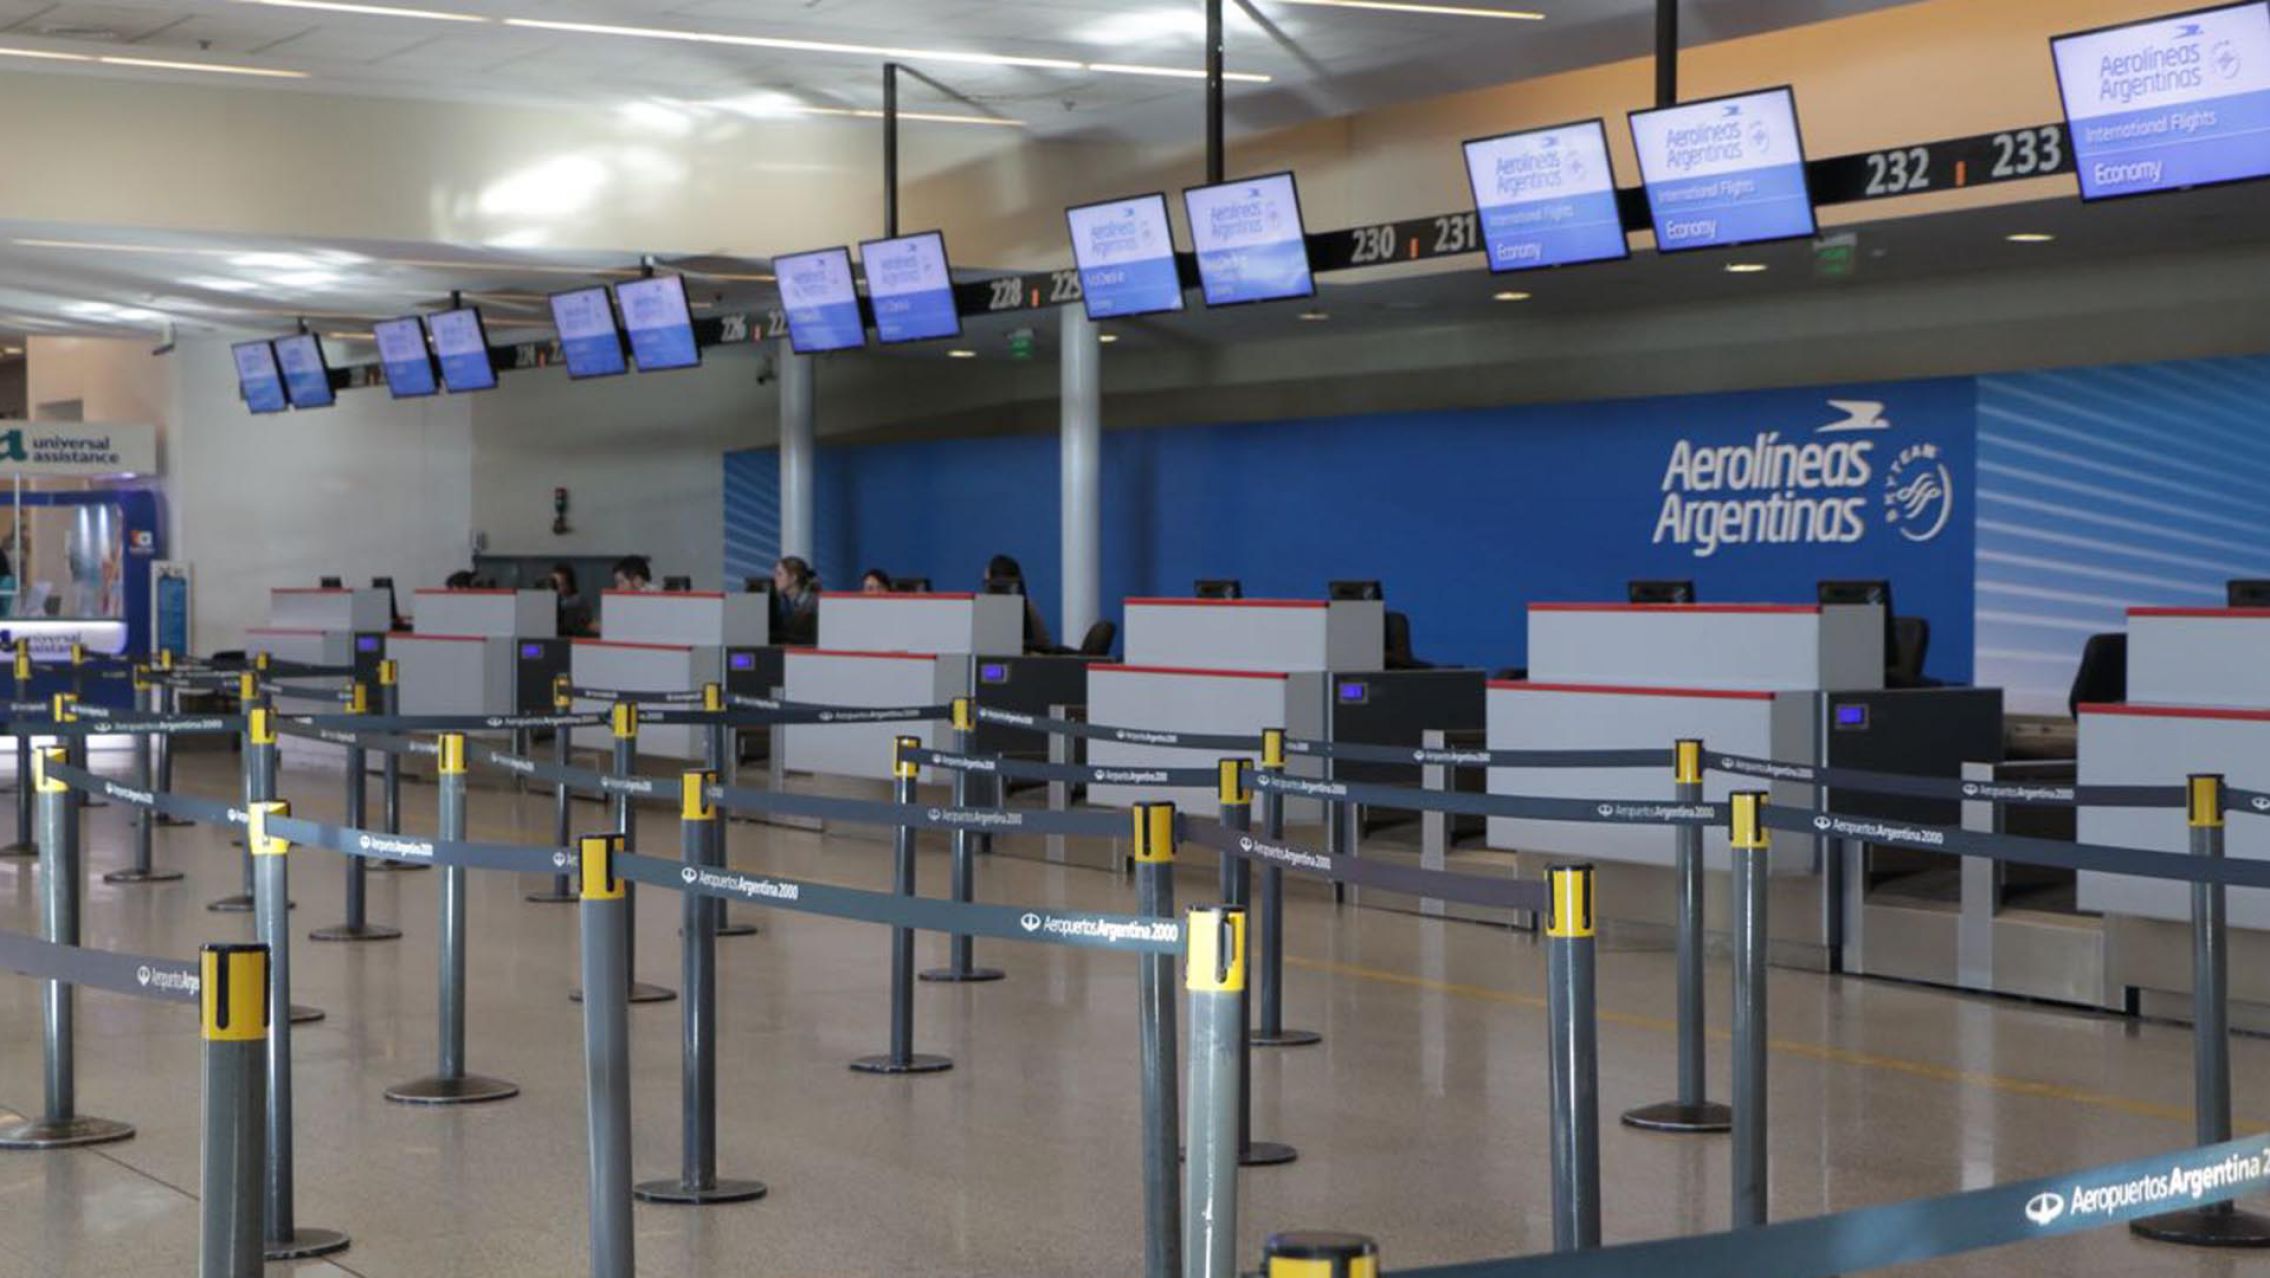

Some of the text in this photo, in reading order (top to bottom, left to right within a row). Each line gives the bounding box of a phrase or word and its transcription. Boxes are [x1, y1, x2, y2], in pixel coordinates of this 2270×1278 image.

[2100, 67, 2202, 103] Argentinas
[2086, 111, 2217, 143] International Flights
[1666, 142, 1743, 171] Argentinas
[1991, 126, 2063, 179] 233
[1865, 147, 1930, 196] 232
[2094, 160, 2162, 185] Economy
[1350, 225, 1396, 264] 230
[1434, 214, 1477, 251] 231
[1665, 219, 1717, 240] Economy
[989, 276, 1022, 311] 228
[32, 436, 110, 450] universal
[33, 451, 120, 464] assistance
[1661, 431, 1874, 491] Aerolíneas
[1652, 490, 1868, 557] Argentinas
[1151, 921, 1179, 943] 2000
